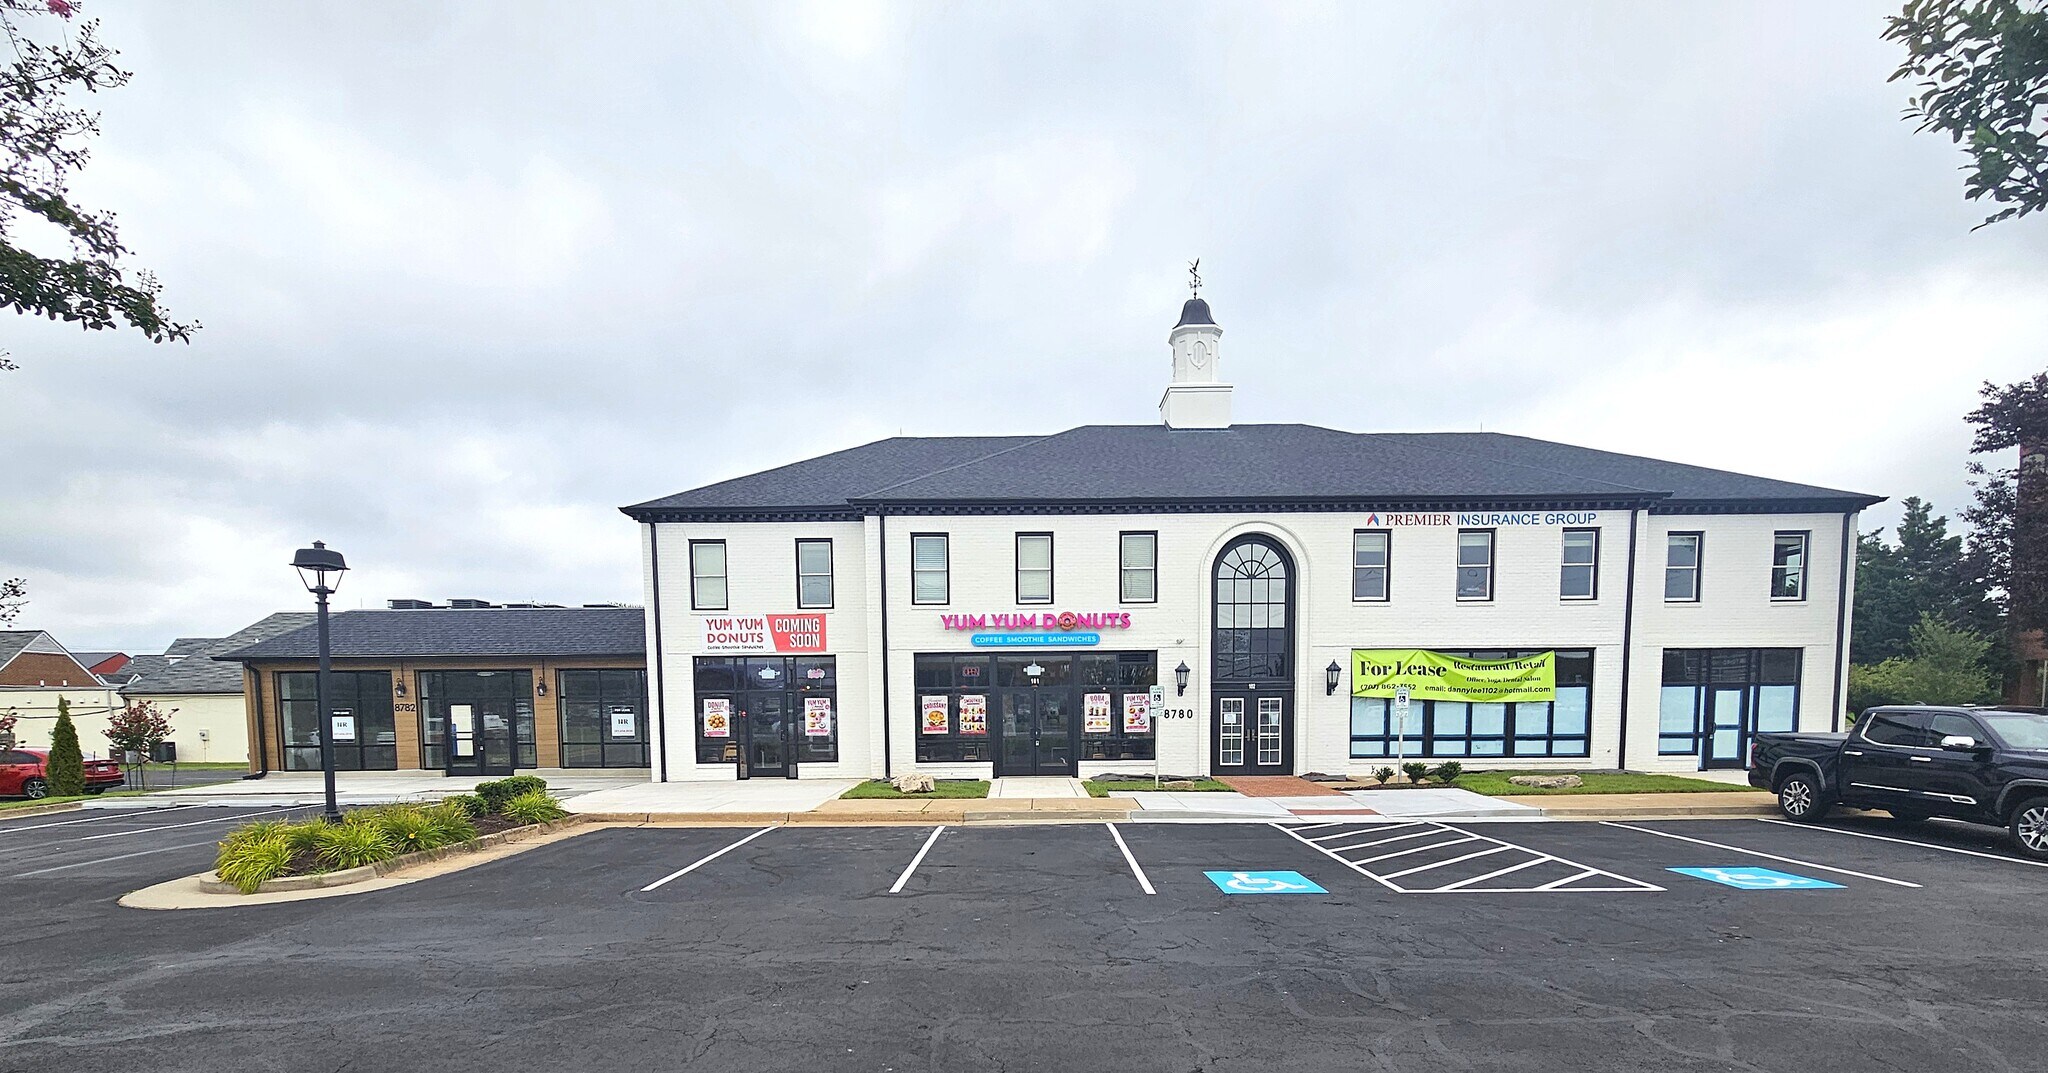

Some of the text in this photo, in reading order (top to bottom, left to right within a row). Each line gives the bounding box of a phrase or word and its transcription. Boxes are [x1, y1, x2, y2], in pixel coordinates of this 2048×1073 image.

[1386, 513, 1597, 526] PREMIER INSURANCE GROUP
[706, 618, 763, 630] YUM YUM
[775, 618, 820, 633] COMING
[940, 611, 1131, 631] YUM YUM DONUTS
[707, 633, 764, 643] DONUTS
[790, 633, 820, 648] SOON
[1048, 635, 1097, 643] SANDWICHES
[1360, 660, 1447, 677] For Lease
[1454, 659, 1546, 671] Restaurant/Retail
[395, 703, 415, 712] 8782
[1164, 709, 1193, 719] 8780
